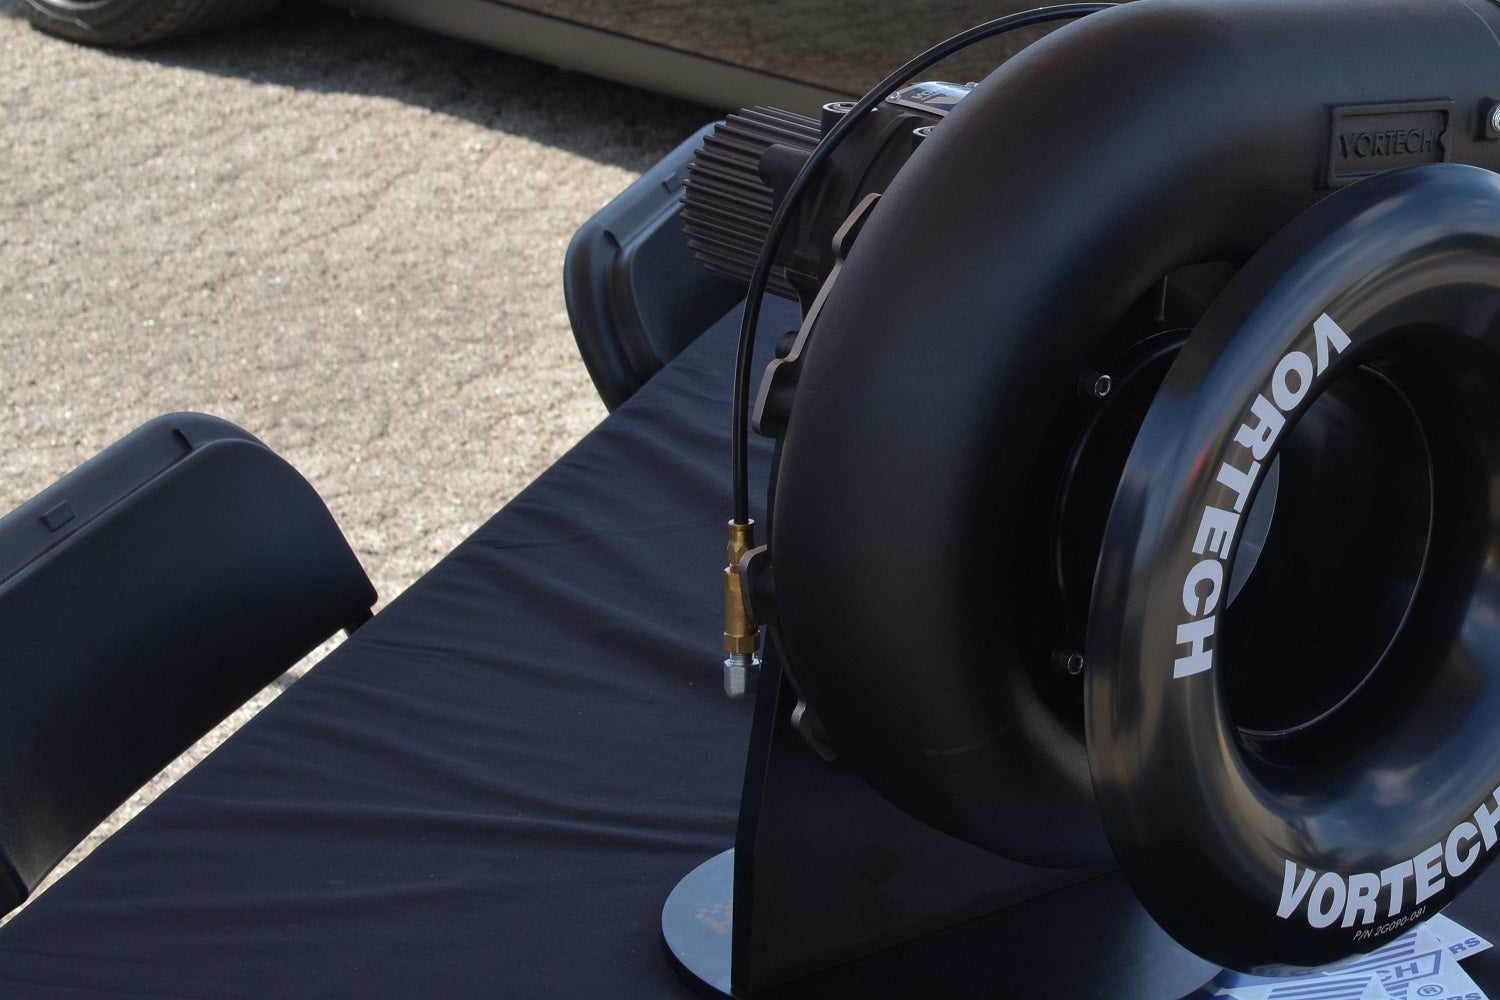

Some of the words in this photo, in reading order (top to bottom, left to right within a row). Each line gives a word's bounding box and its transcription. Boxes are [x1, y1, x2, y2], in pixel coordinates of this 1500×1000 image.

[1338, 127, 1436, 159] VORTECH
[1173, 312, 1352, 680] VORTECH
[1353, 928, 1374, 942] P/N
